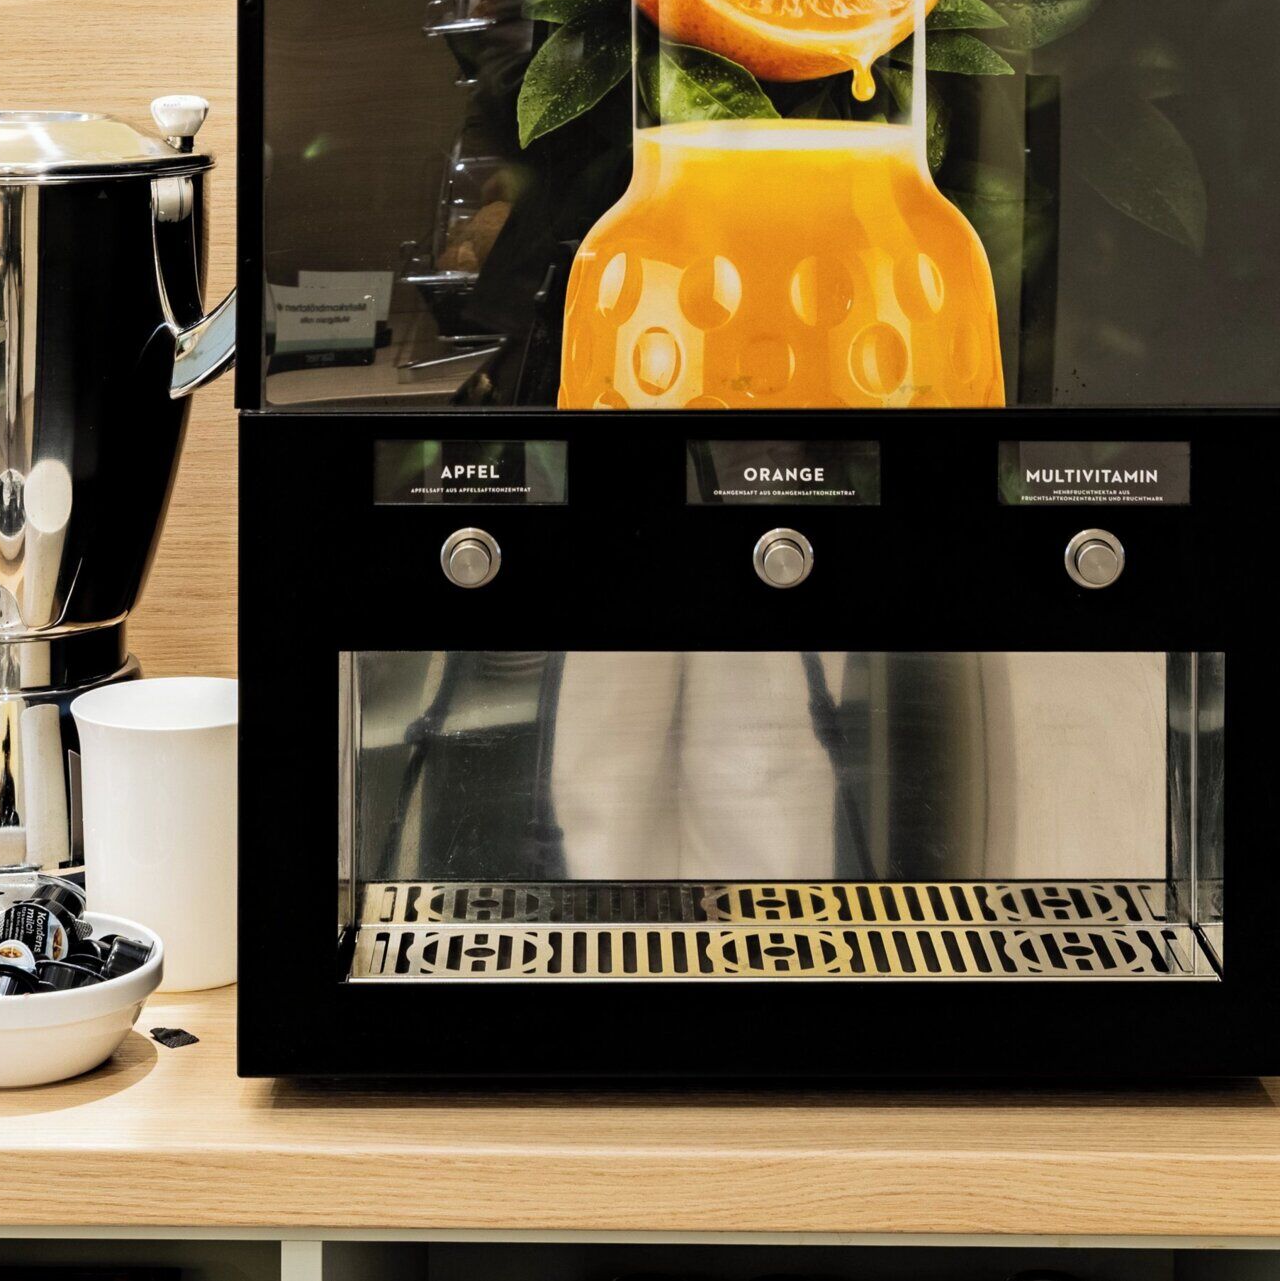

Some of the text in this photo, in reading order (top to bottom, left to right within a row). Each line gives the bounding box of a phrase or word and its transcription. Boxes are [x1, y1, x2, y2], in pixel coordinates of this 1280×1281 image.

[440, 464, 500, 479] APFEL
[743, 467, 825, 482] ORANGE
[1026, 469, 1158, 483] MULTIVITAMIN
[24, 908, 35, 935] milch
[32, 911, 48, 954] Kondens
